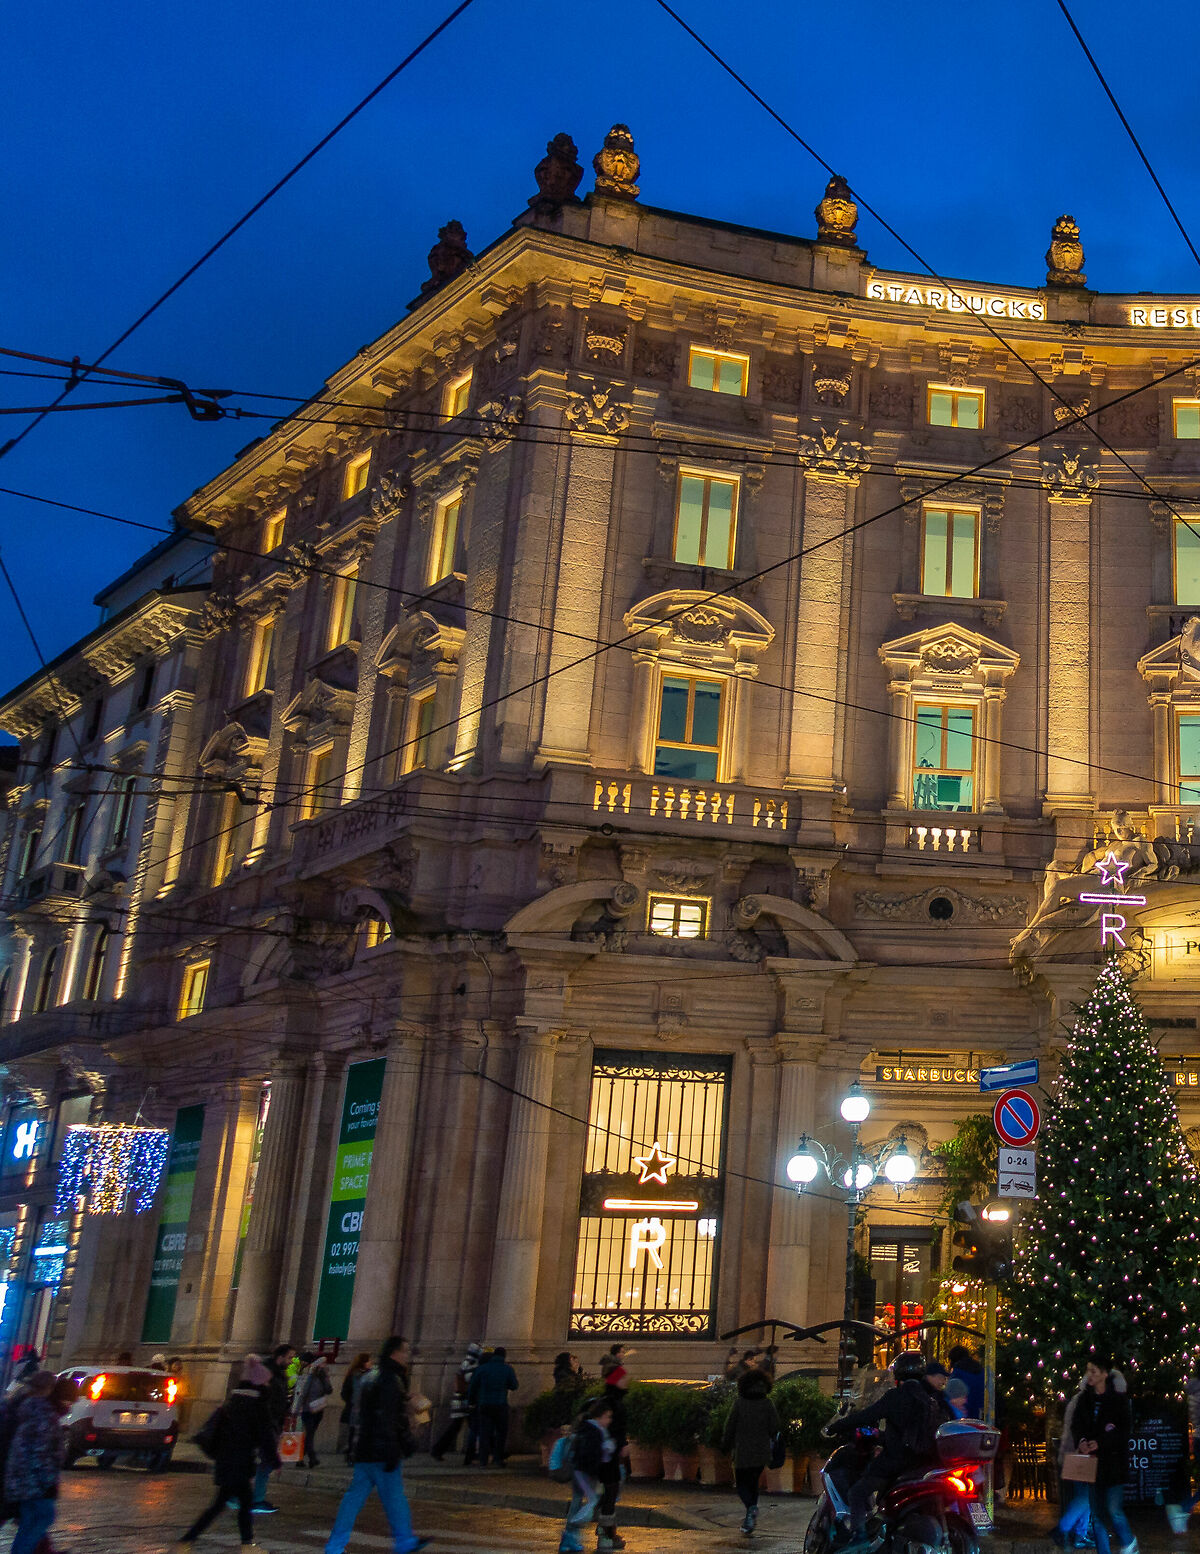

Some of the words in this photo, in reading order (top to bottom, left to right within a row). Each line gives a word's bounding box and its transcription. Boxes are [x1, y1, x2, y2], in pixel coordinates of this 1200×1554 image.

[871, 284, 1043, 319] STARBUCKS
[1101, 912, 1127, 948] R
[882, 1067, 979, 1083] STARBUCK
[350, 1099, 377, 1116] Coming
[343, 1152, 367, 1169] PRIME
[1007, 1156, 1028, 1166] 0-24
[340, 1174, 365, 1191] SPACE
[331, 1242, 341, 1257] 02
[629, 1221, 667, 1269] R
